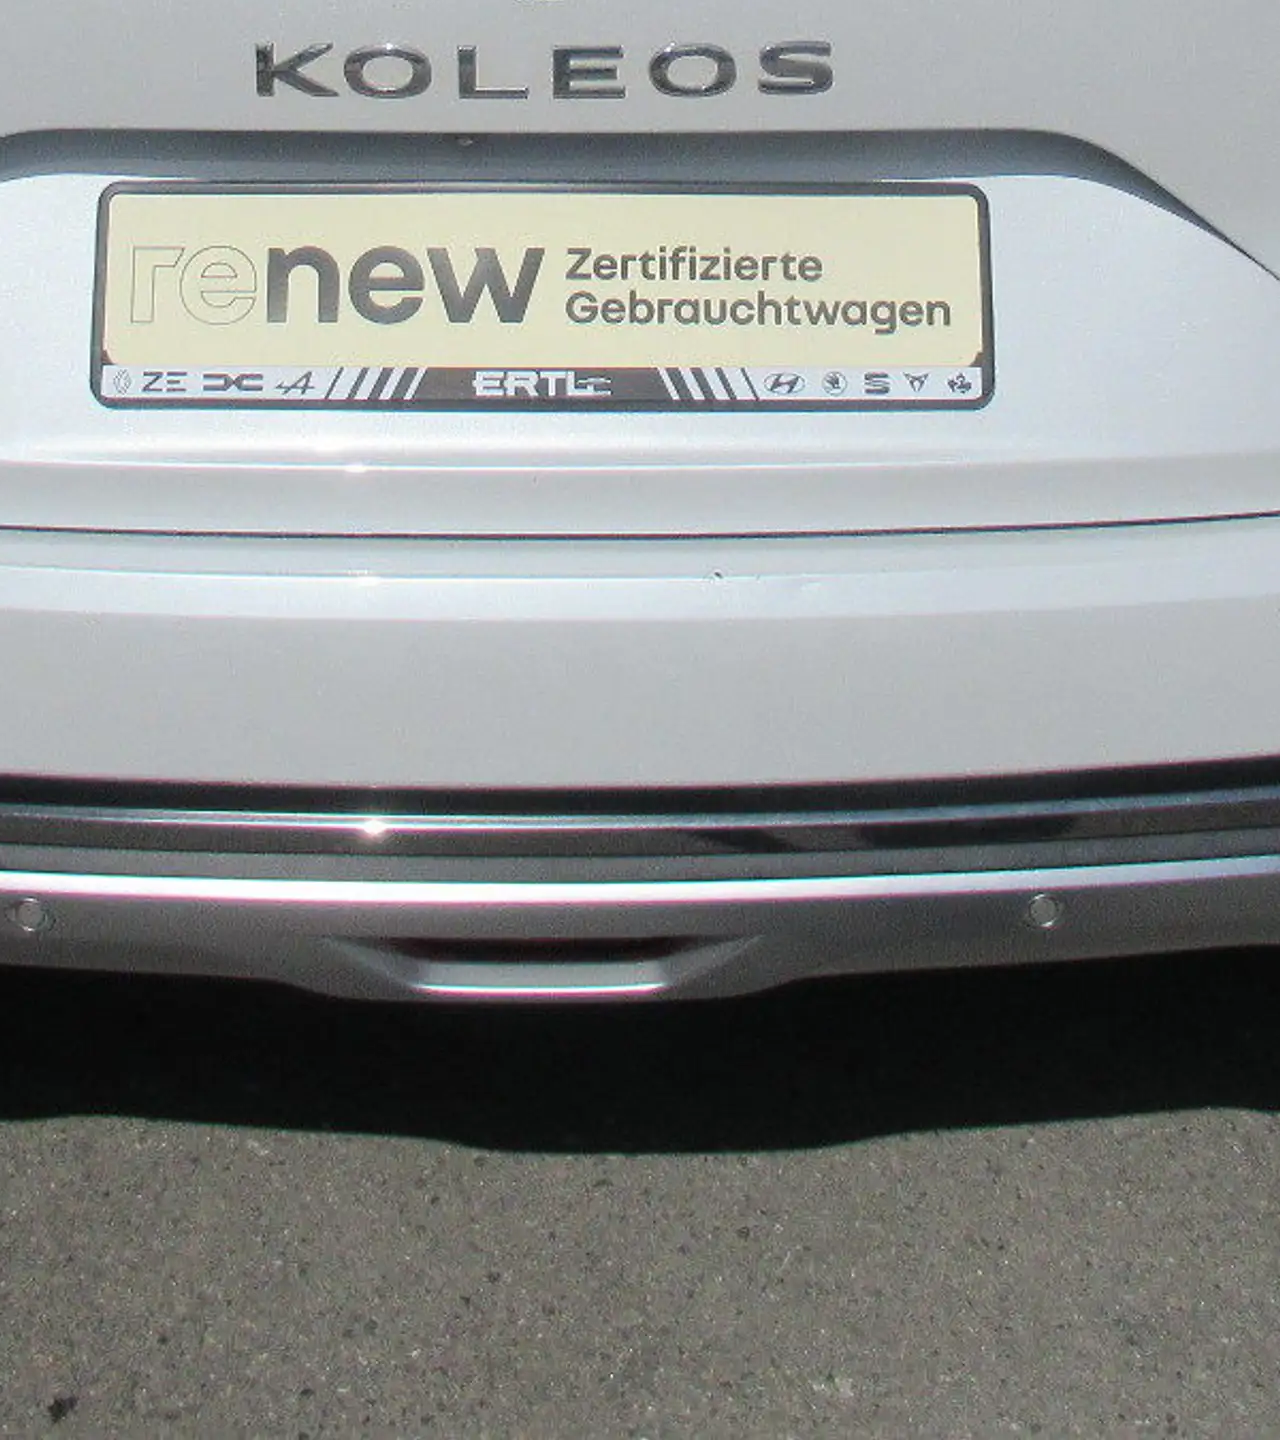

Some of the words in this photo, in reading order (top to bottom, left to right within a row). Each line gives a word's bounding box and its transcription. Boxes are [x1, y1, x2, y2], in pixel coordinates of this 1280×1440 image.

[255, 40, 834, 100] KOLEOS
[129, 245, 547, 326] renew
[564, 245, 824, 282] Zertifizierte
[564, 290, 952, 336] Gebrauchtwagen
